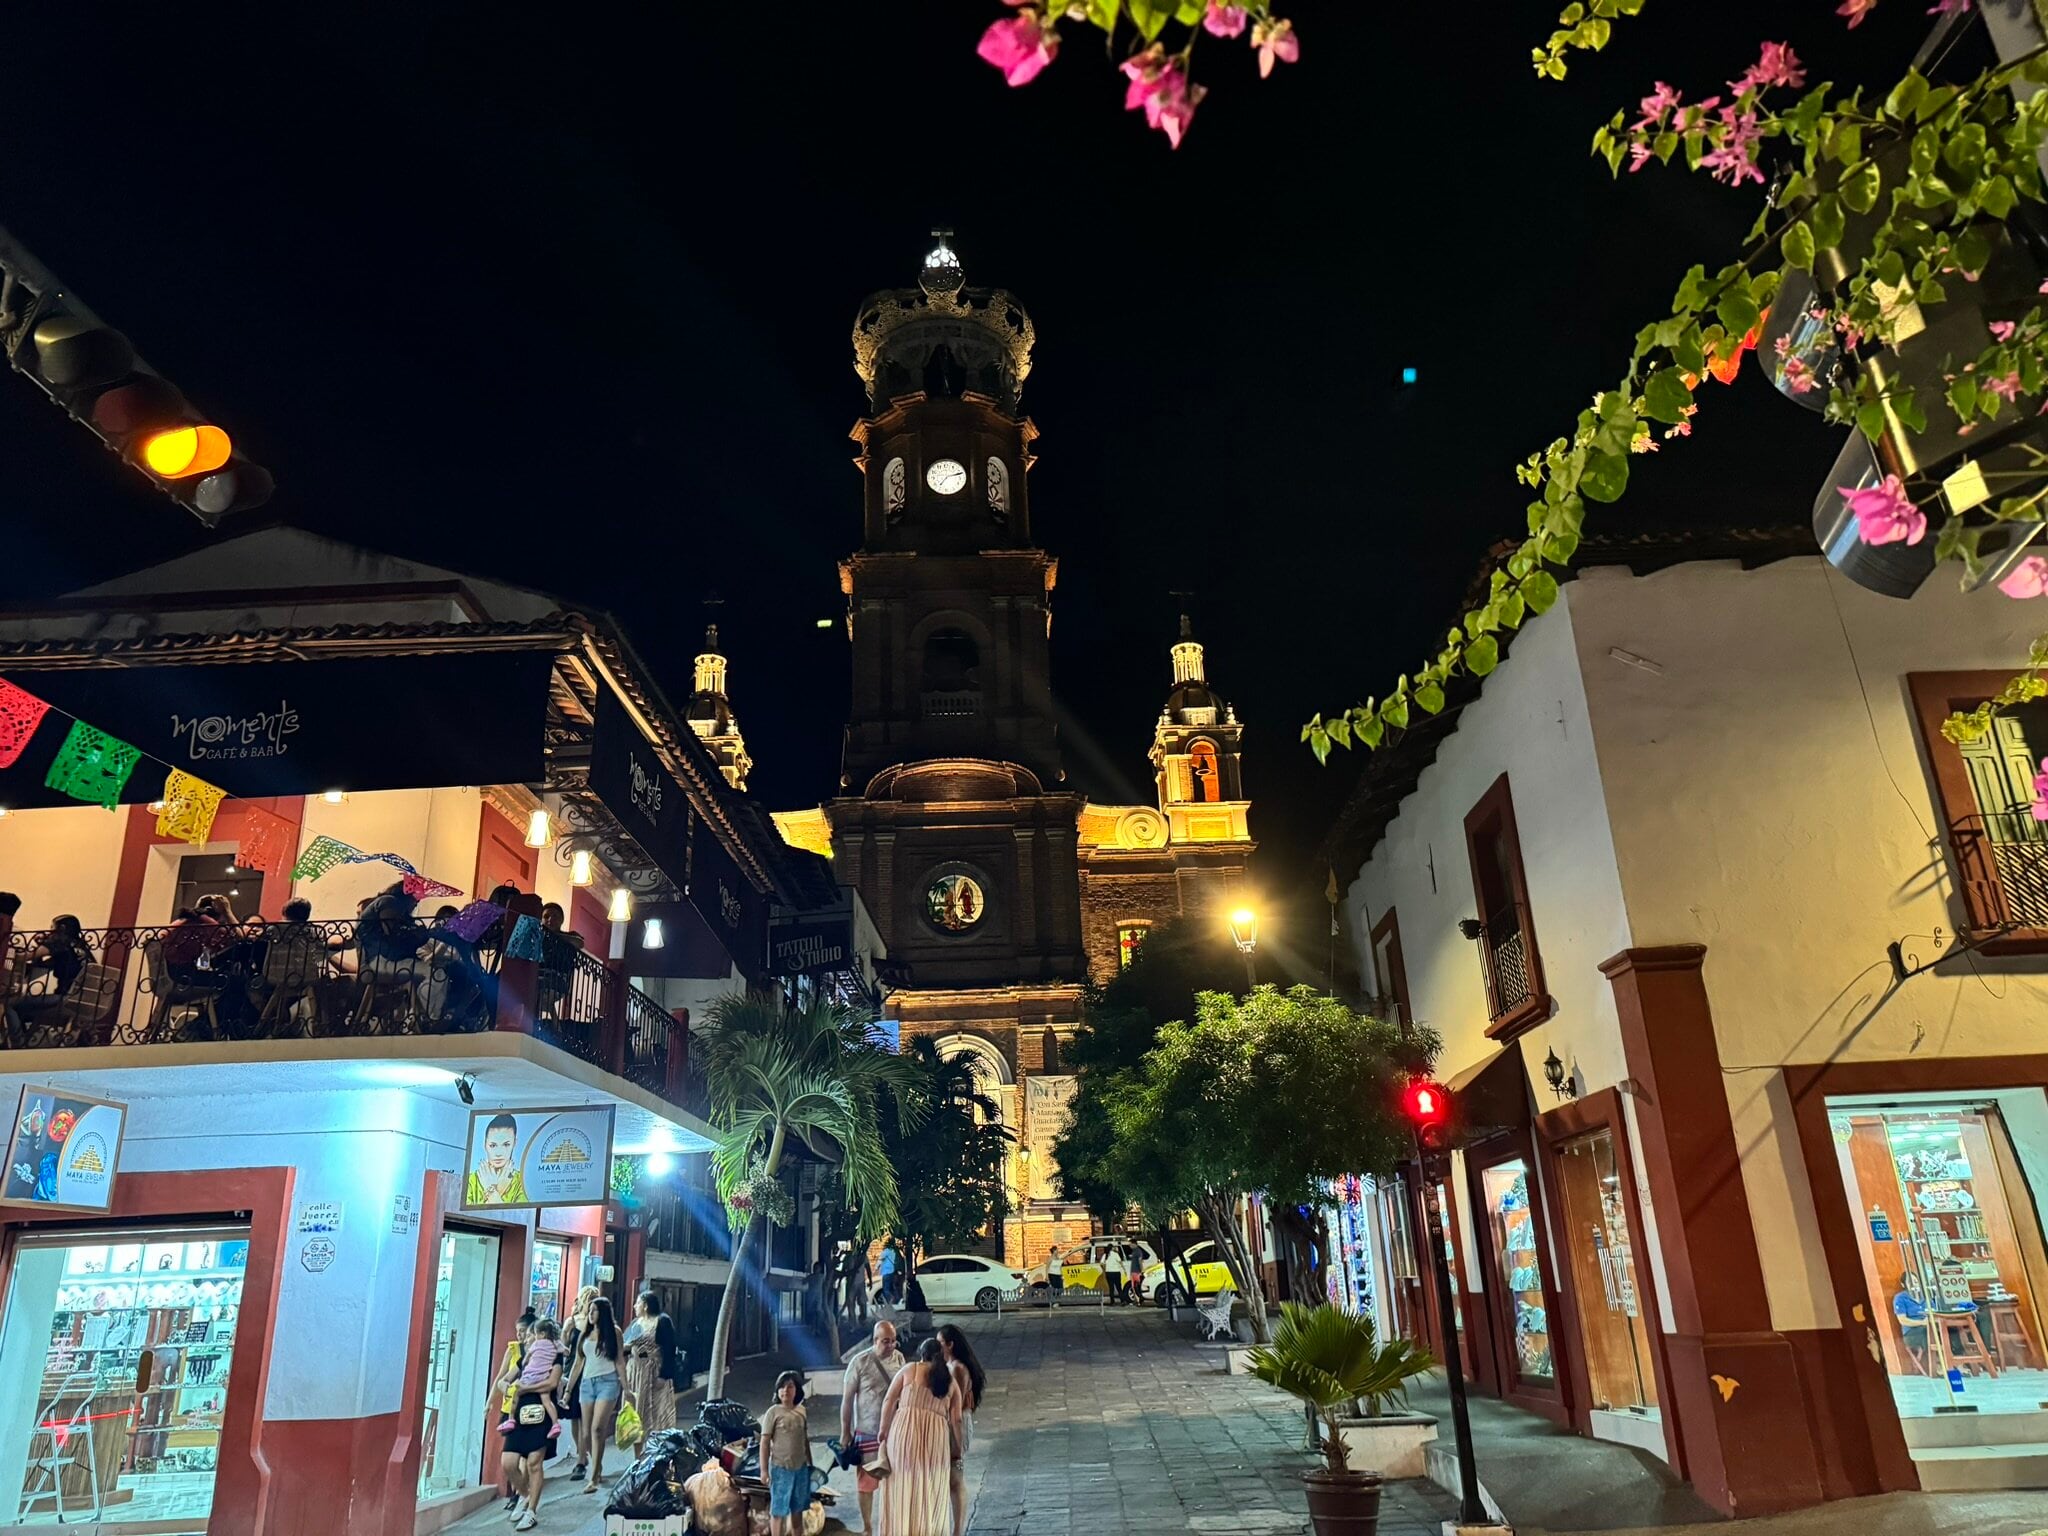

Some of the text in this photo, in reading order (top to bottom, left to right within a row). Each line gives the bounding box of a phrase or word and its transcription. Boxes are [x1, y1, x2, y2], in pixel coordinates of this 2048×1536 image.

[206, 746, 274, 760] CAFÉ & BAR
[564, 1162, 593, 1170] JEWELRY
[65, 1171, 83, 1179] MAYA
[309, 1202, 332, 1211] calle
